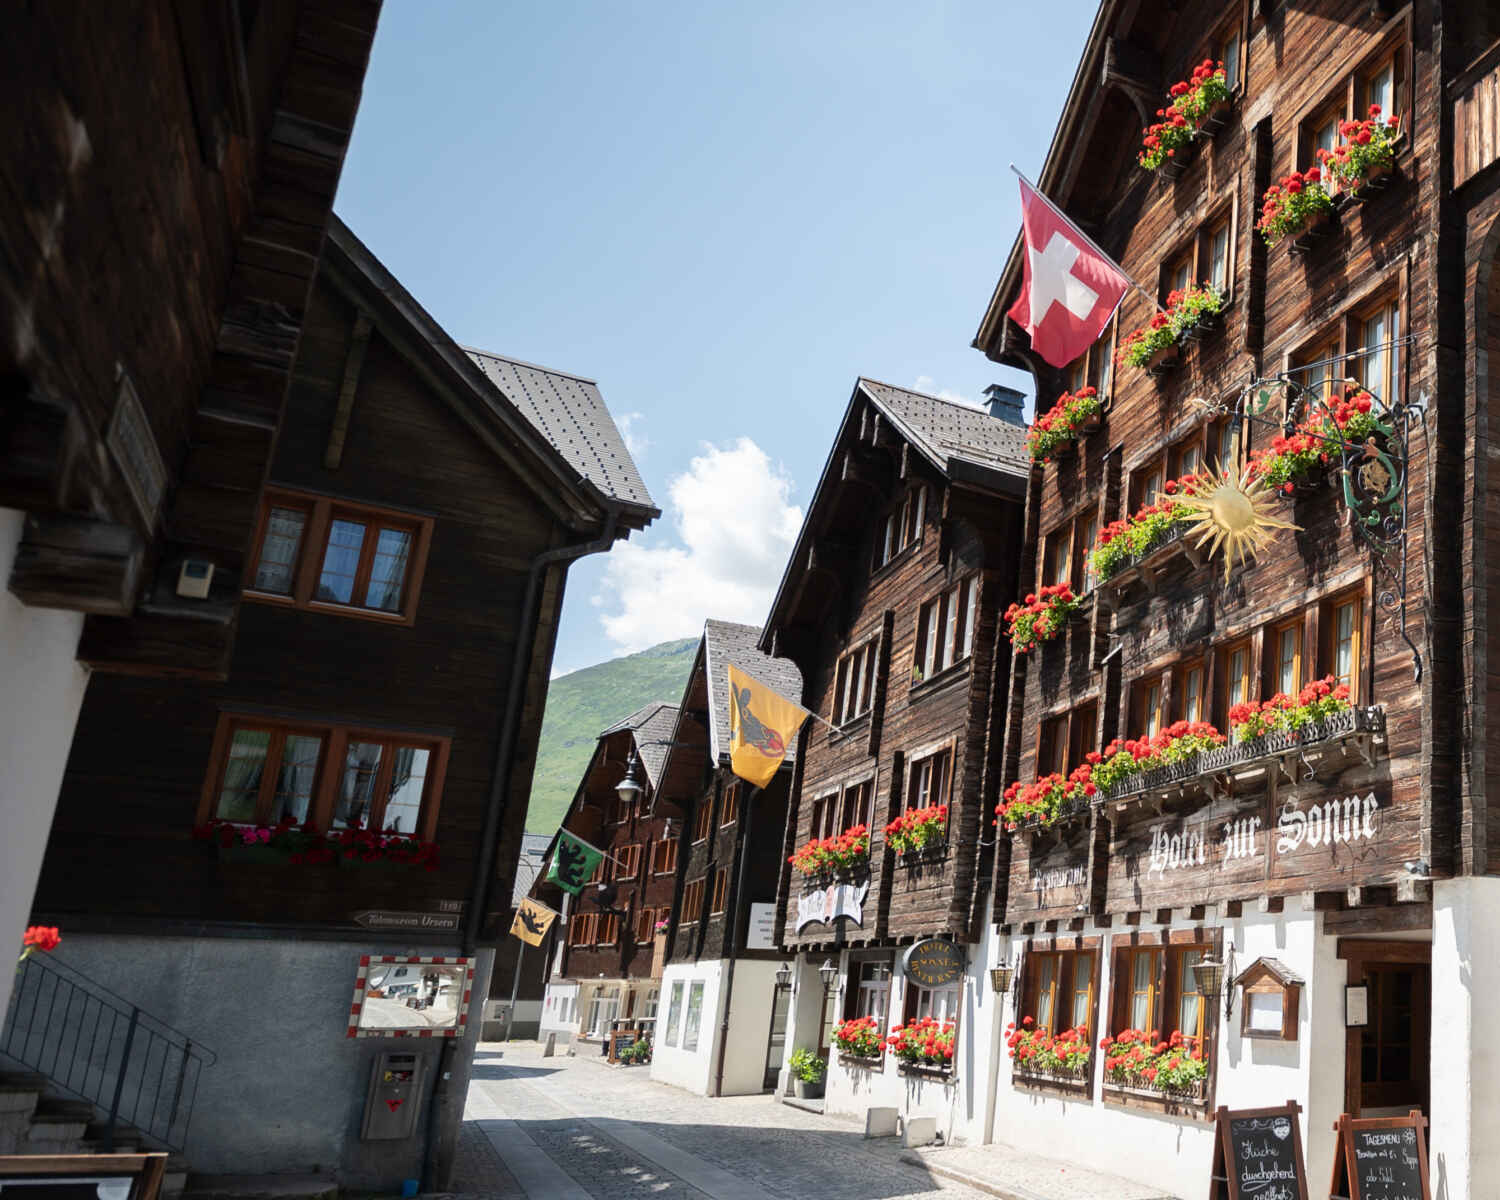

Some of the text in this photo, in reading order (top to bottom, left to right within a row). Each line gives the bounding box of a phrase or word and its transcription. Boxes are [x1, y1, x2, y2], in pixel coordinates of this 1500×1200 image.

[1146, 791, 1380, 882] Hotel zur Sonne
